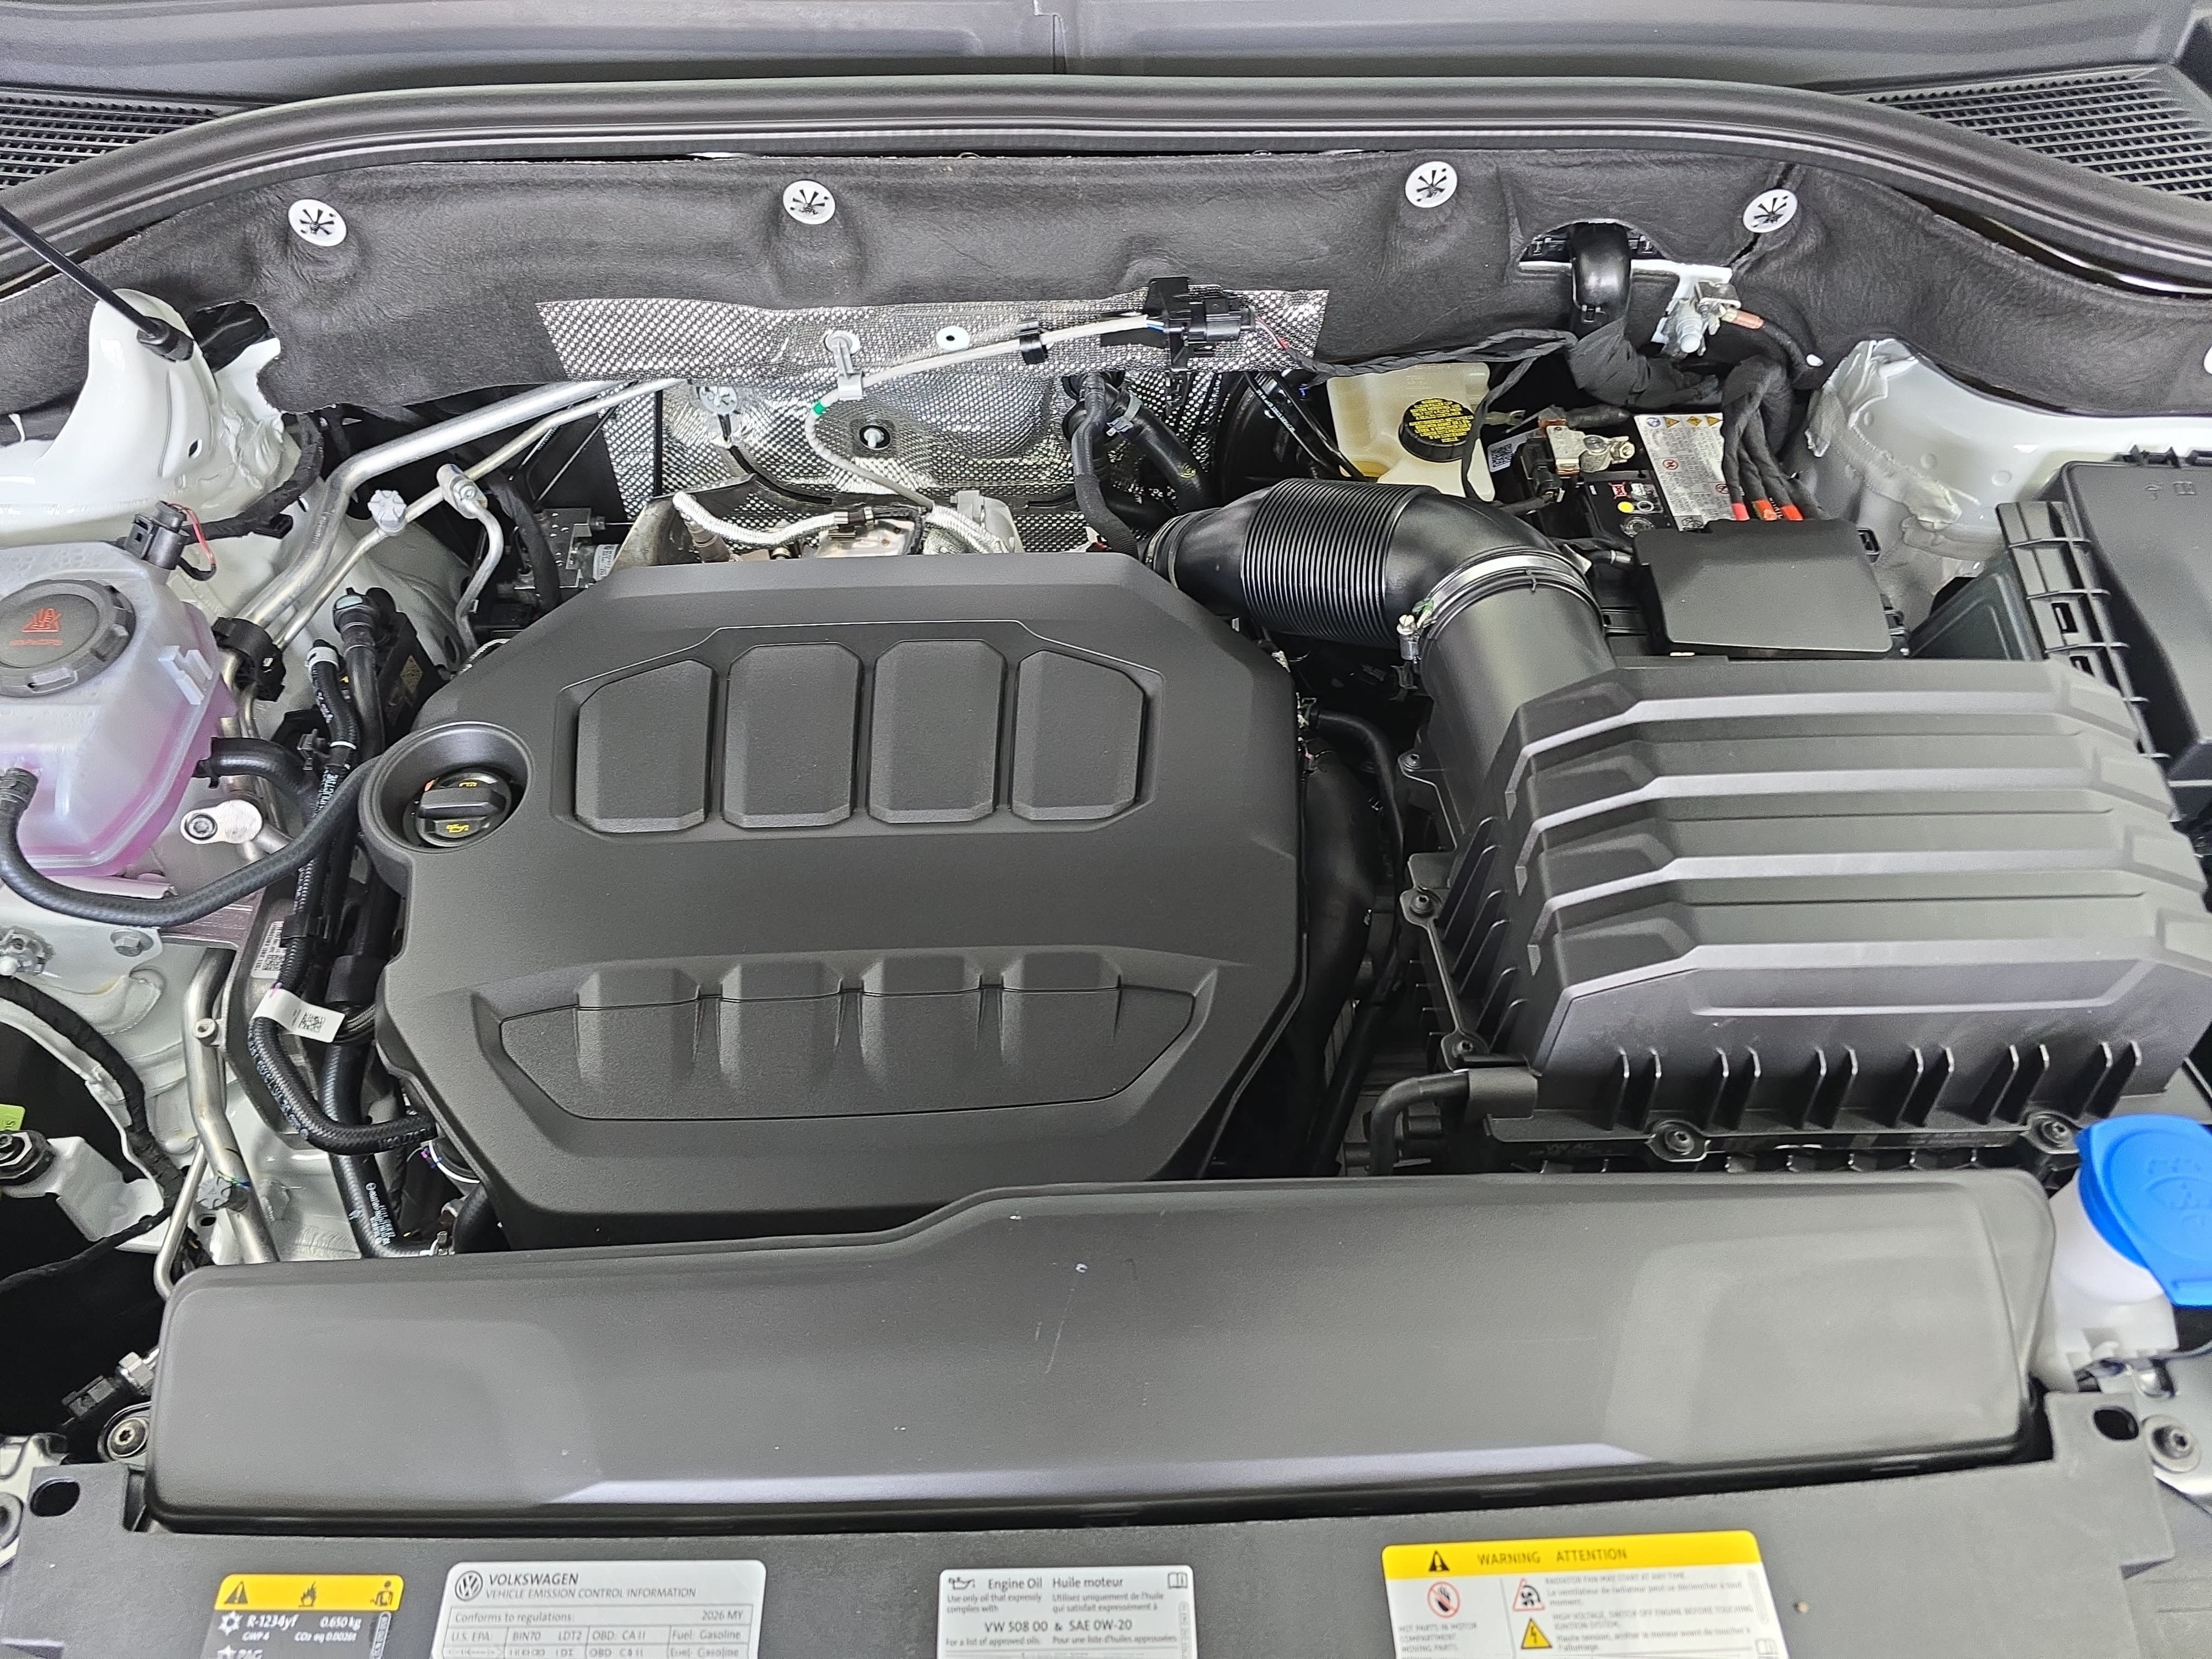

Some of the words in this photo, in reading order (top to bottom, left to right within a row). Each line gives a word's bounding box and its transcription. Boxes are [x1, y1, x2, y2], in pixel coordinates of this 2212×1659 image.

[1476, 1551, 1541, 1566] WARNING
[1556, 1548, 1628, 1562] ATTENTION
[489, 1573, 579, 1586] VOLKSWAGEN
[988, 1578, 1025, 1592] Engine
[1027, 1577, 1043, 1590] Oil
[1052, 1577, 1081, 1588] Huile
[1084, 1577, 1123, 1587] moteur
[486, 1589, 523, 1599] VEHICLE
[528, 1588, 576, 1598] EMISSION
[578, 1588, 622, 1598] CONTROL
[627, 1587, 697, 1598] INFORMATION
[247, 1614, 299, 1631] R-1234yf
[455, 1612, 501, 1623] Conforms
[505, 1612, 515, 1623] to
[702, 1610, 725, 1621] 2026
[728, 1609, 744, 1620] MY
[985, 1621, 1006, 1633] VW
[1008, 1621, 1030, 1632] 508
[1032, 1621, 1049, 1632] 00
[1054, 1622, 1063, 1631] &
[1069, 1620, 1090, 1631] SAE
[1093, 1619, 1133, 1631] 0W-20
[512, 1631, 542, 1641] BIN70
[558, 1630, 582, 1641] LDT2
[699, 1629, 742, 1640] Gasoline
